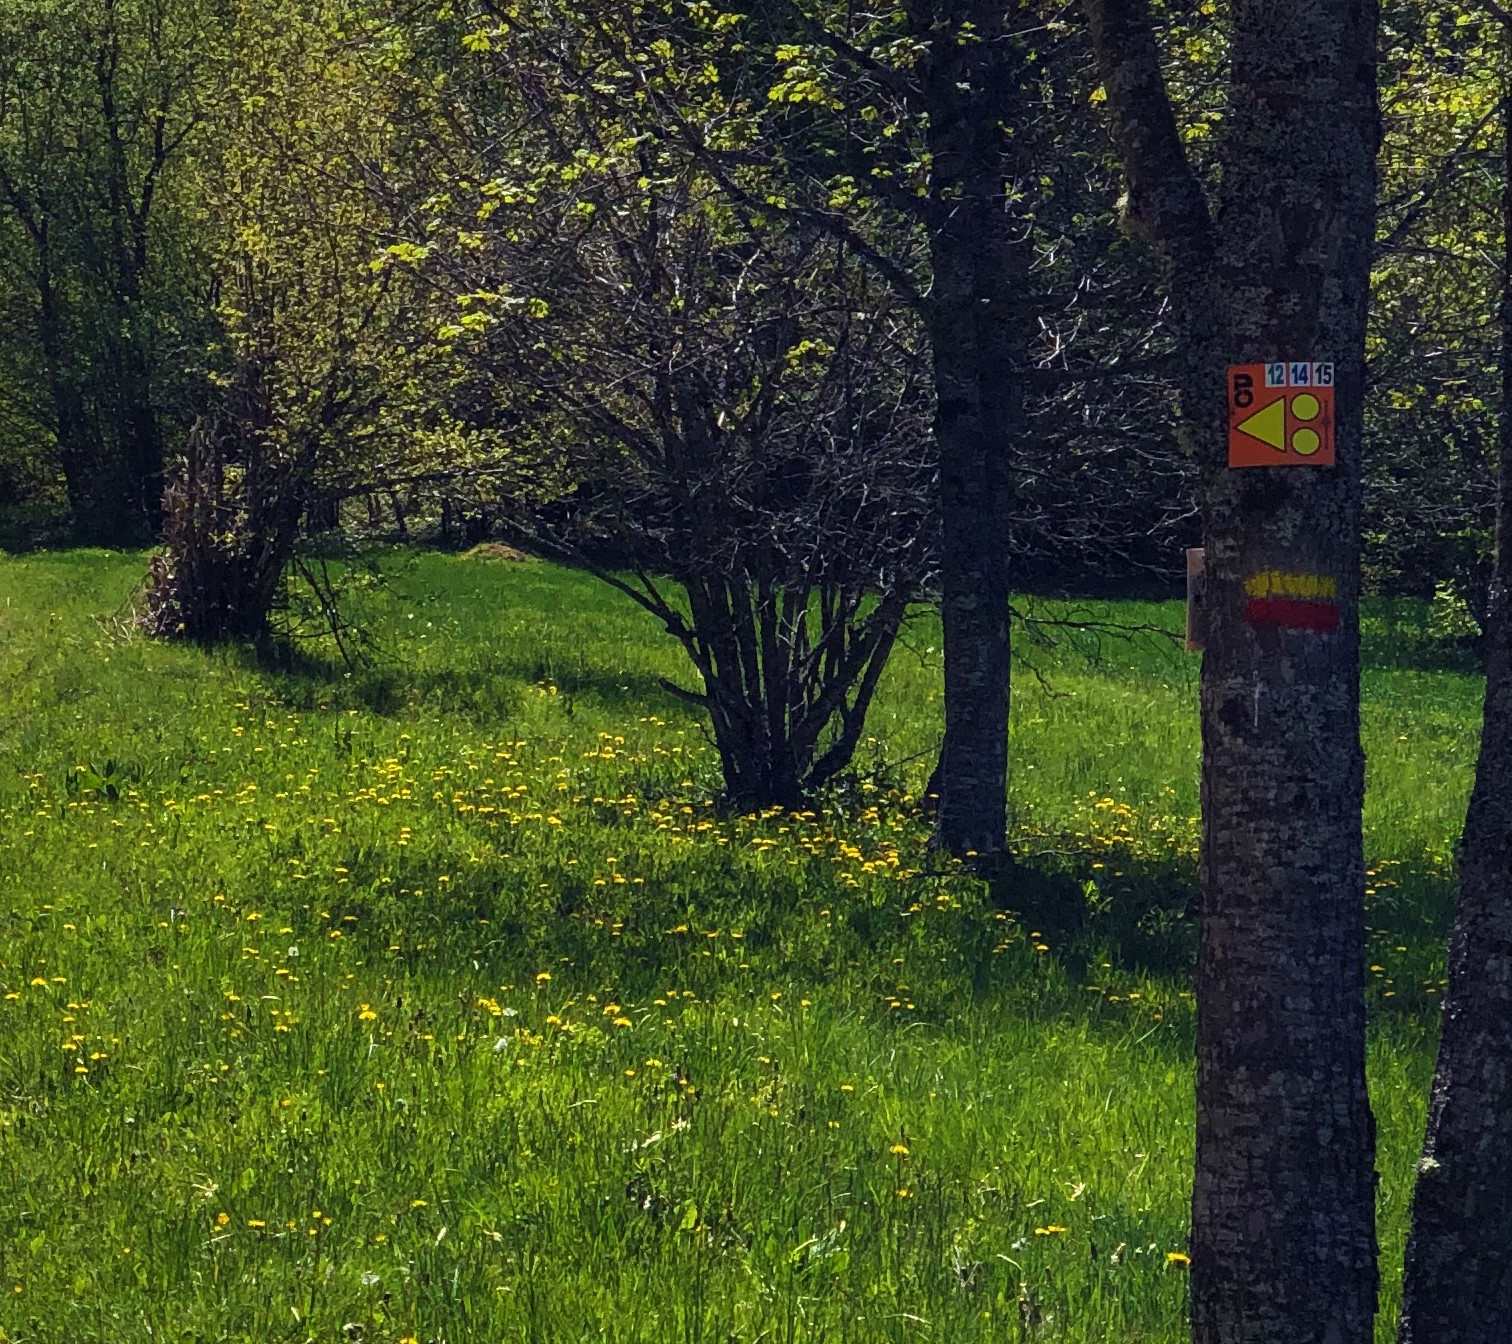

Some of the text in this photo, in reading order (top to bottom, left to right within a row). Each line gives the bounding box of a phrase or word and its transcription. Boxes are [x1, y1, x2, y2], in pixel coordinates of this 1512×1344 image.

[1268, 364, 1332, 385] 12 14 15
